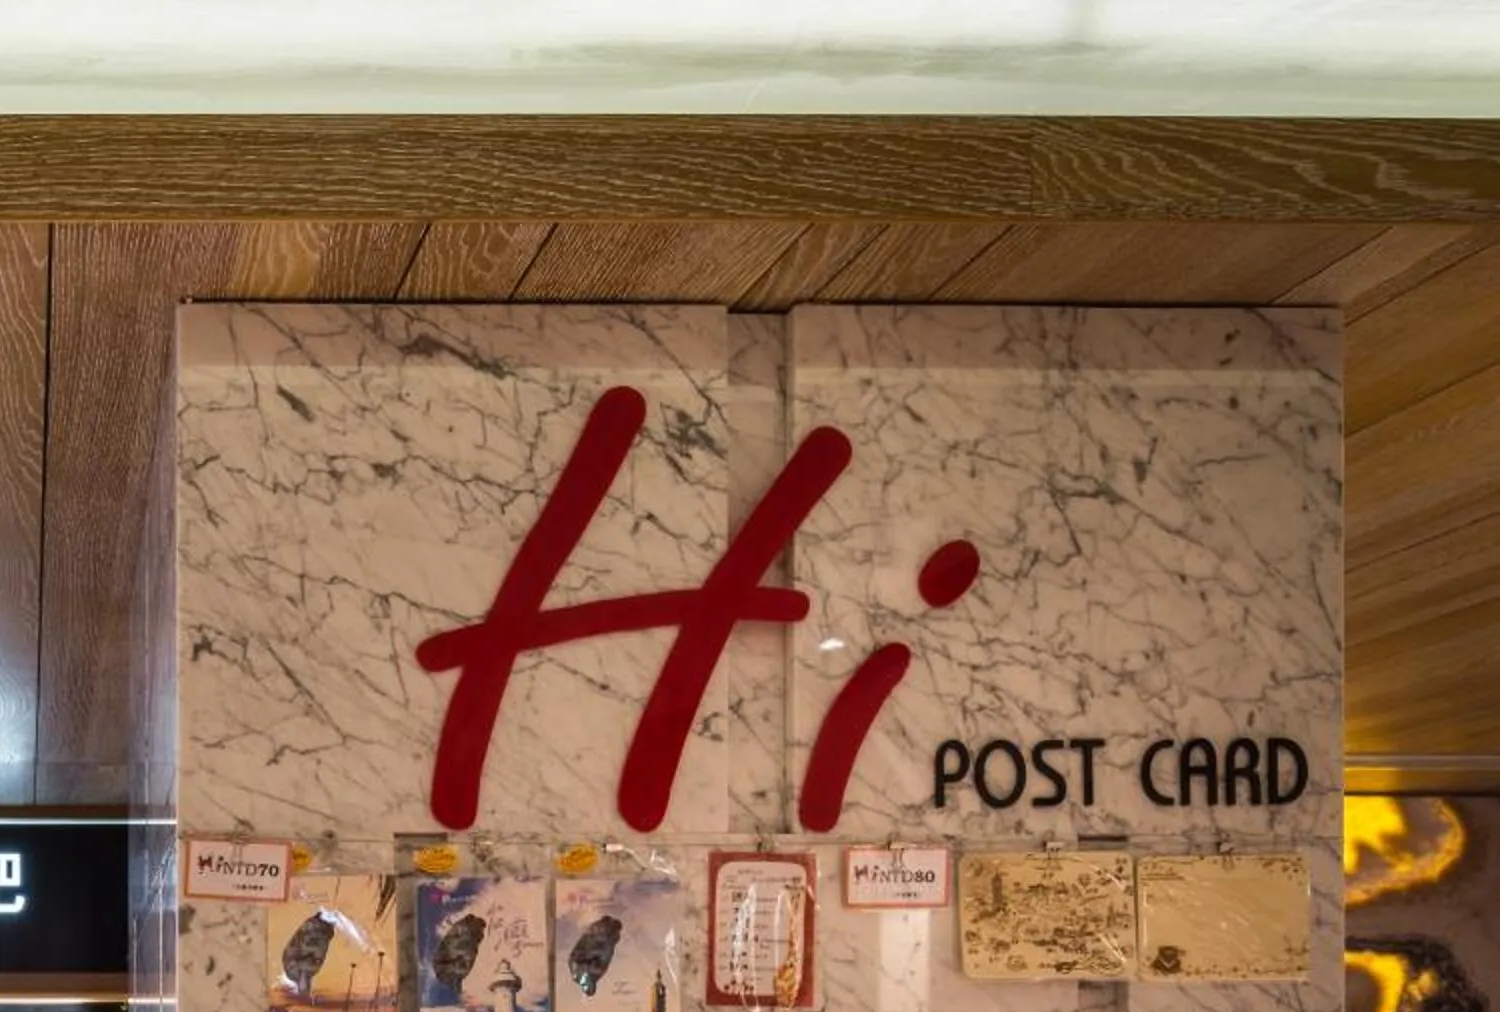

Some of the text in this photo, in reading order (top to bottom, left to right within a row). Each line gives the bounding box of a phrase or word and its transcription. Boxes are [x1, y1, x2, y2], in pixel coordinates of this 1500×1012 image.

[416, 385, 981, 834] Hi
[934, 737, 1310, 810] POST CARD
